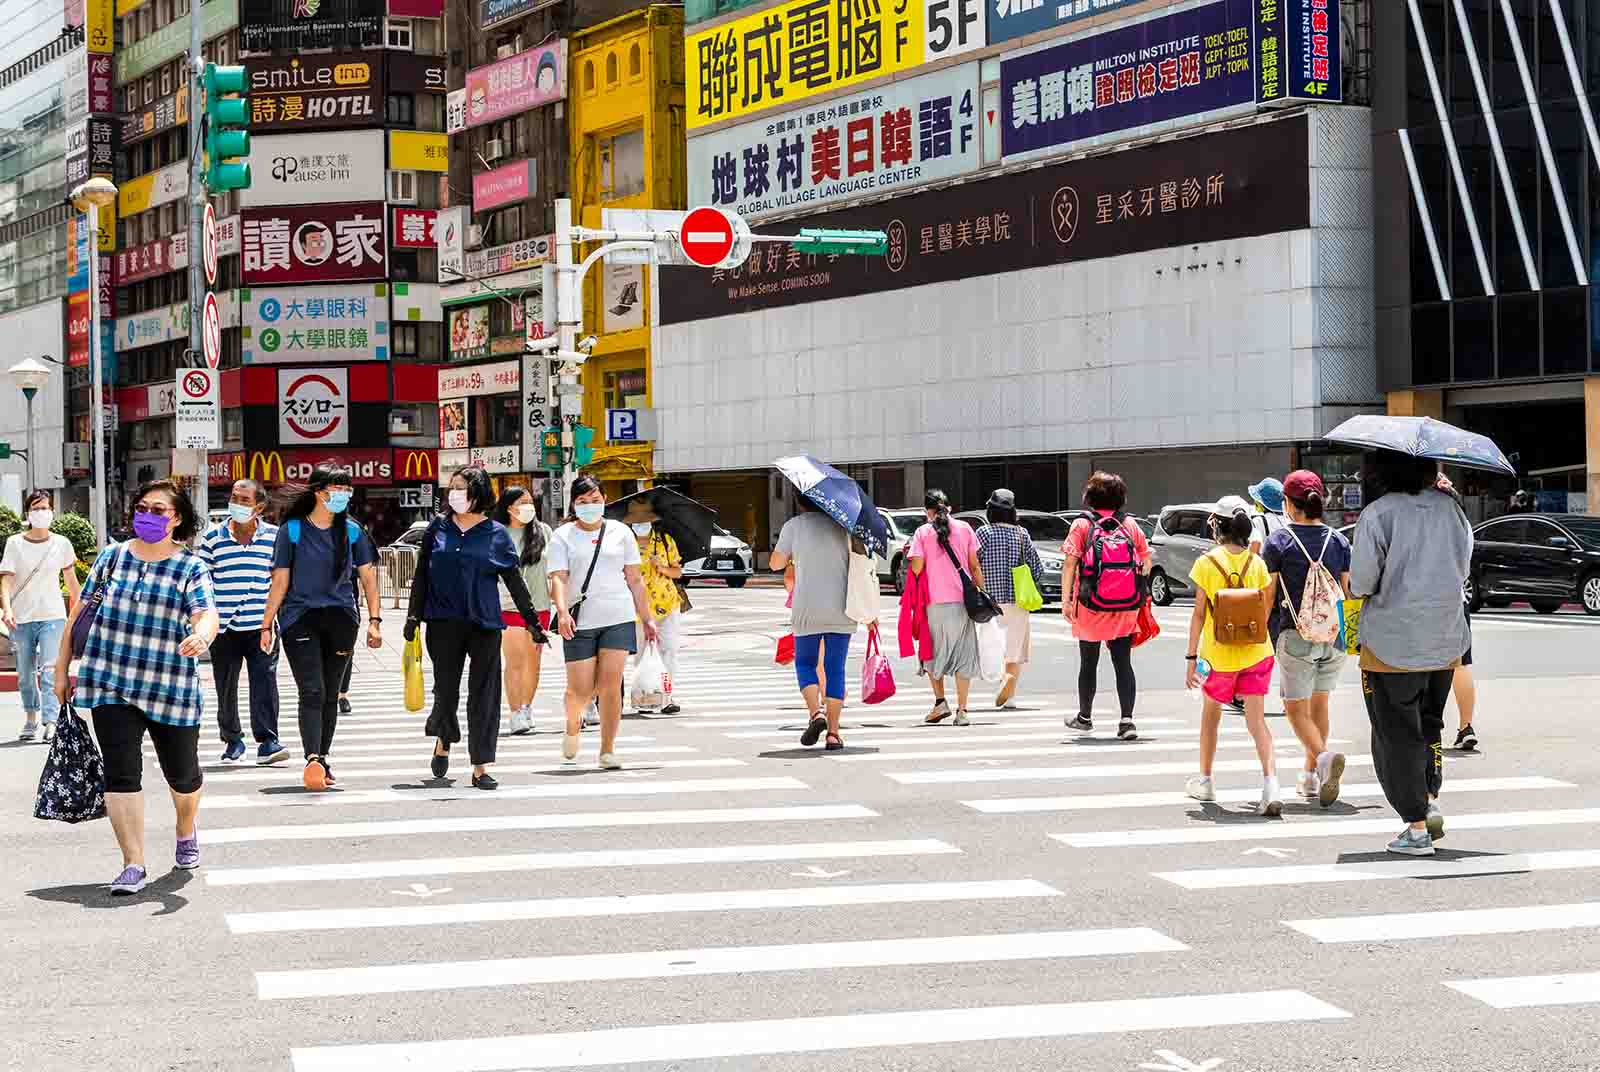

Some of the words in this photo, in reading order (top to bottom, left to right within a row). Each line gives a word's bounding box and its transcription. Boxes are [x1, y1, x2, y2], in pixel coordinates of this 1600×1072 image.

[266, 24, 310, 33] International
[312, 22, 345, 30] Business
[347, 20, 371, 28] Center
[929, 0, 977, 52] 5F
[698, 0, 882, 118] 聯成電腦
[1096, 51, 1136, 70] MILTON
[1139, 35, 1199, 60] INSTITUTE
[1302, 12, 1310, 79] INSTITUTE
[1012, 63, 1094, 129] 美爾頓
[1304, 81, 1328, 95] 4F
[252, 96, 304, 122] 詩漫
[307, 96, 374, 118] HOTEL
[958, 88, 974, 154] 4F
[329, 168, 350, 180] Inn
[737, 199, 774, 216] GLOBAL
[775, 190, 816, 210] VILLAGE
[819, 176, 876, 200] LANGUAGE
[879, 166, 921, 188] CENTER
[1096, 172, 1226, 225] 星采牙醫診所
[919, 212, 1011, 255] 星醫美學院
[739, 285, 757, 297] Make
[781, 275, 809, 291] COMING
[810, 271, 831, 286] SOON
[285, 297, 368, 321] 大學眼科
[287, 327, 369, 349] 大學眼鏡
[281, 399, 345, 416] スシロー
[298, 416, 330, 424] TAIWAN
[613, 411, 633, 438] P
